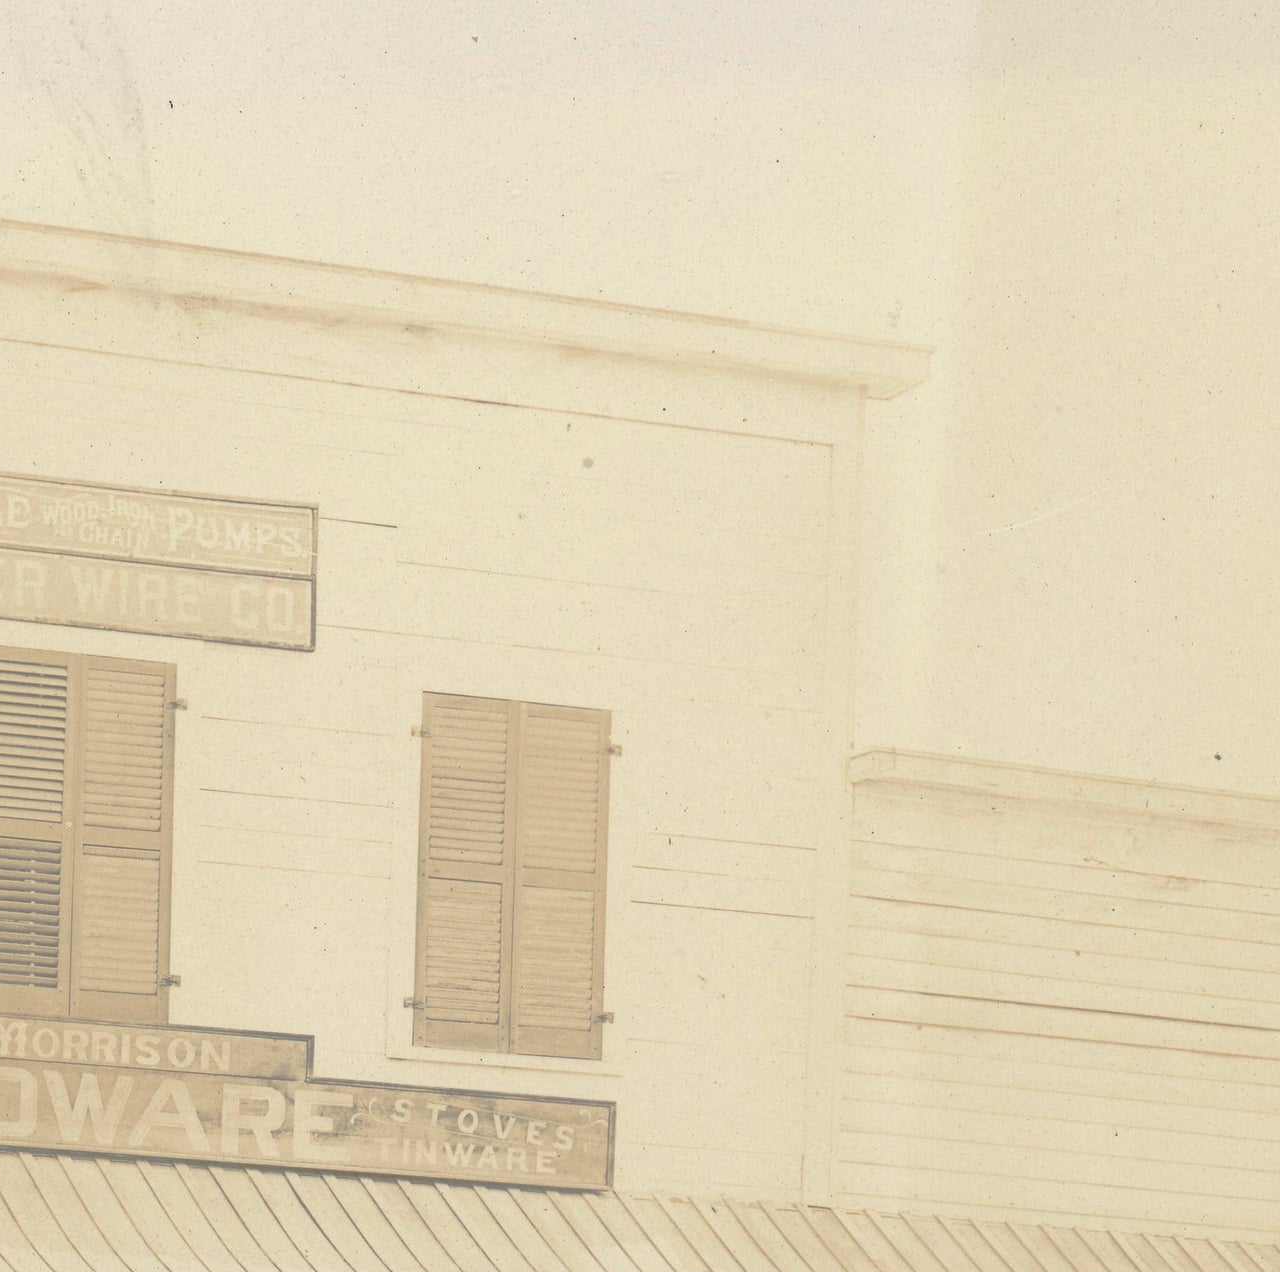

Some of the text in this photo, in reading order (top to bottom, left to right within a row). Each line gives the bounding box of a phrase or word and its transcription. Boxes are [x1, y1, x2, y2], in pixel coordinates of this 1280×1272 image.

[72, 561, 201, 622] WIRE
[391, 1098, 575, 1151] STOVES
[376, 1139, 559, 1175] TINWARE
